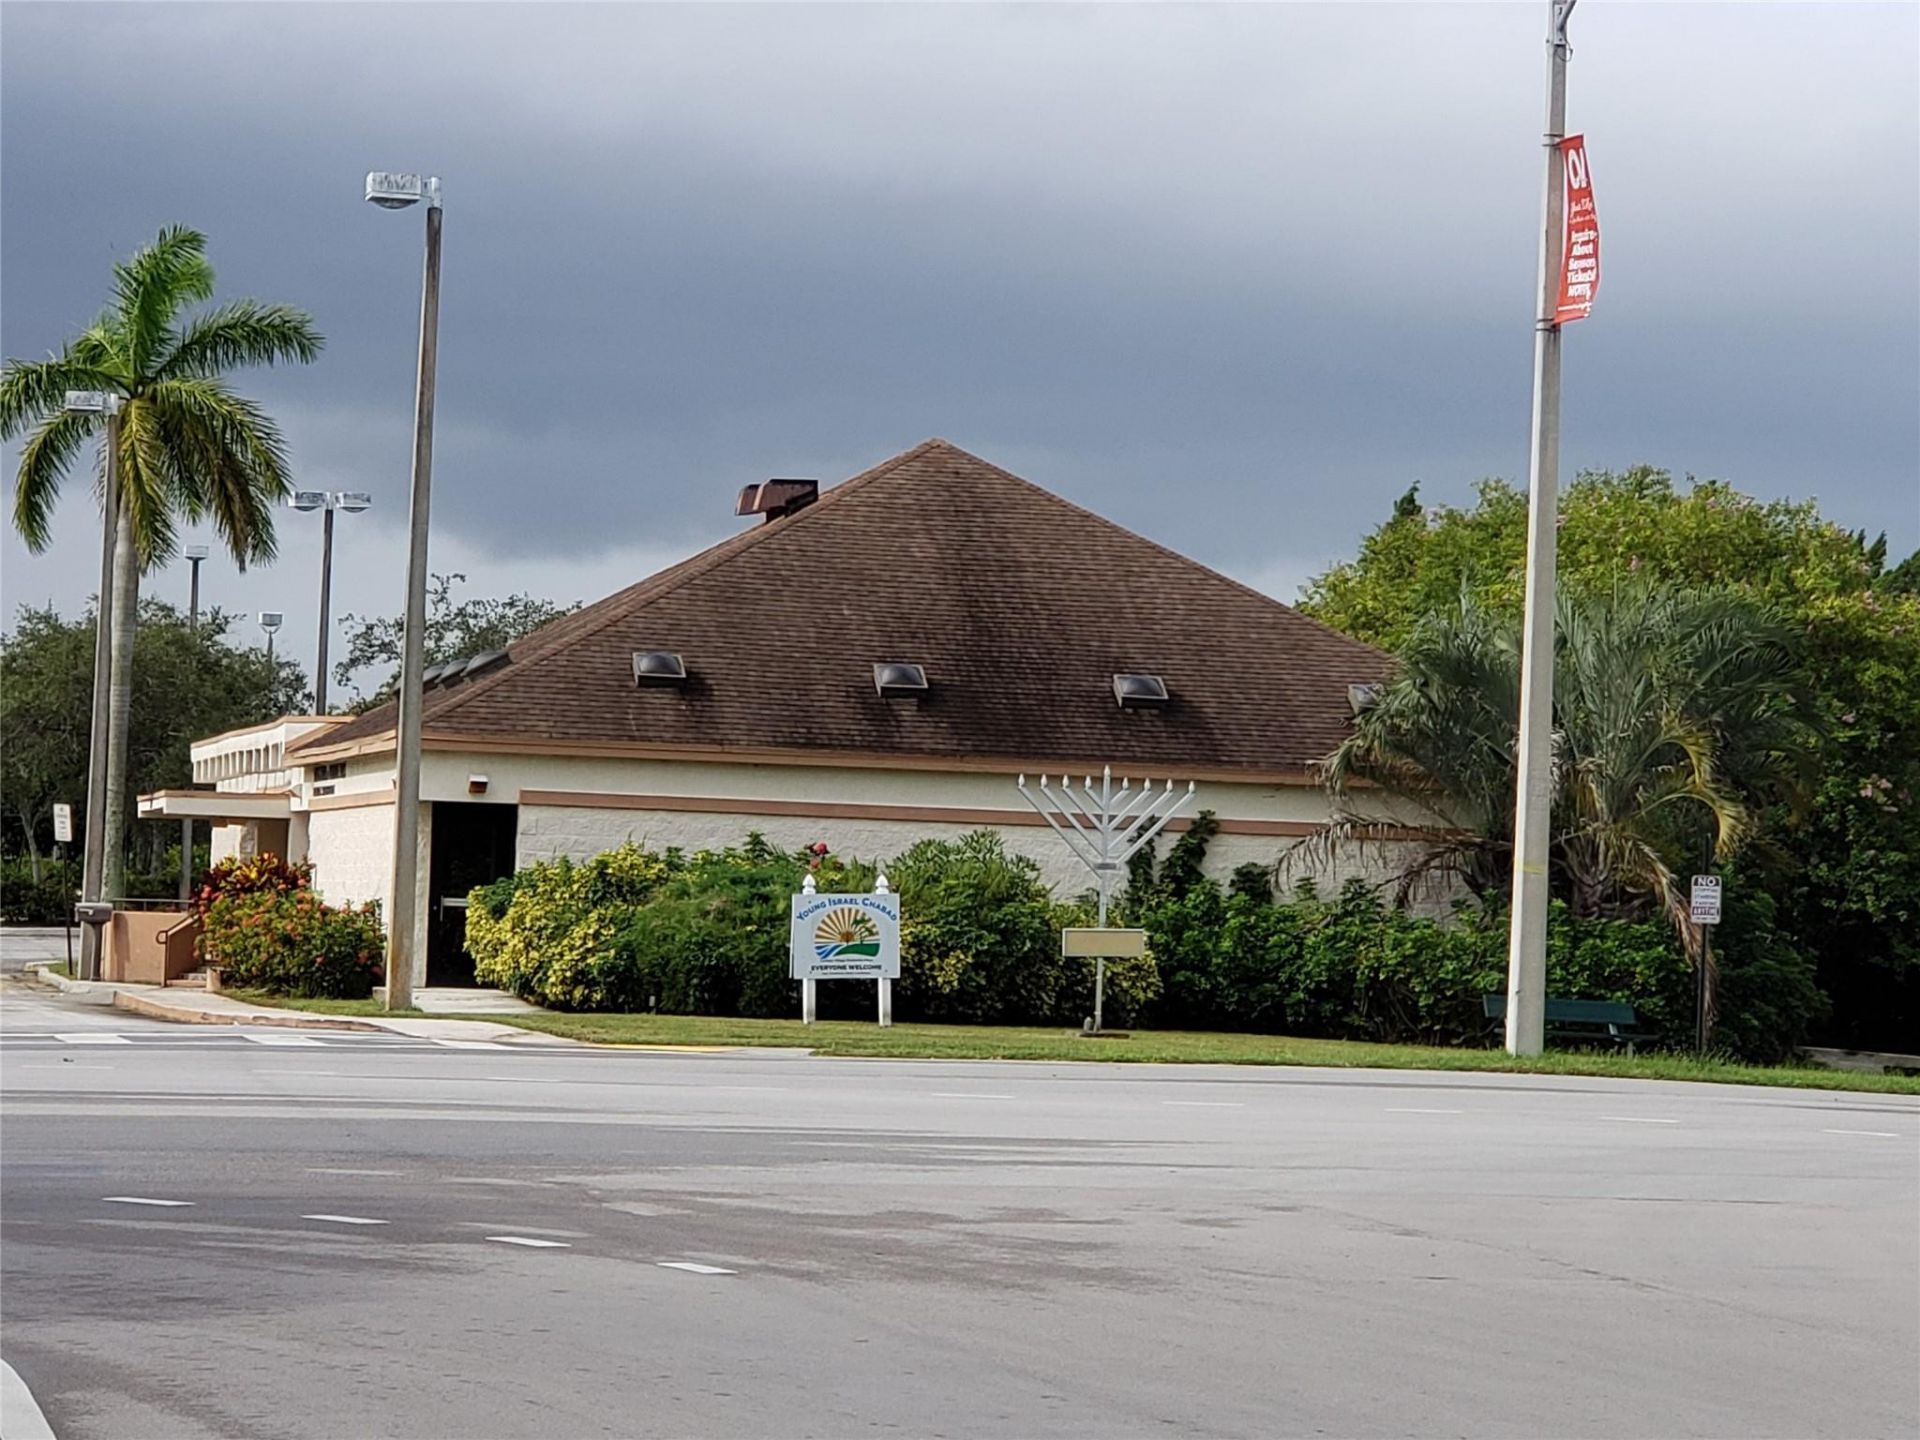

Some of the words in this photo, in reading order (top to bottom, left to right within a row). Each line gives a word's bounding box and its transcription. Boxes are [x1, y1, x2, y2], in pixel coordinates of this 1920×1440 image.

[1697, 877, 1717, 887] NO
[796, 902, 827, 920] YOUNG
[828, 898, 859, 906] ISRAEL
[861, 898, 897, 921] CHABAD
